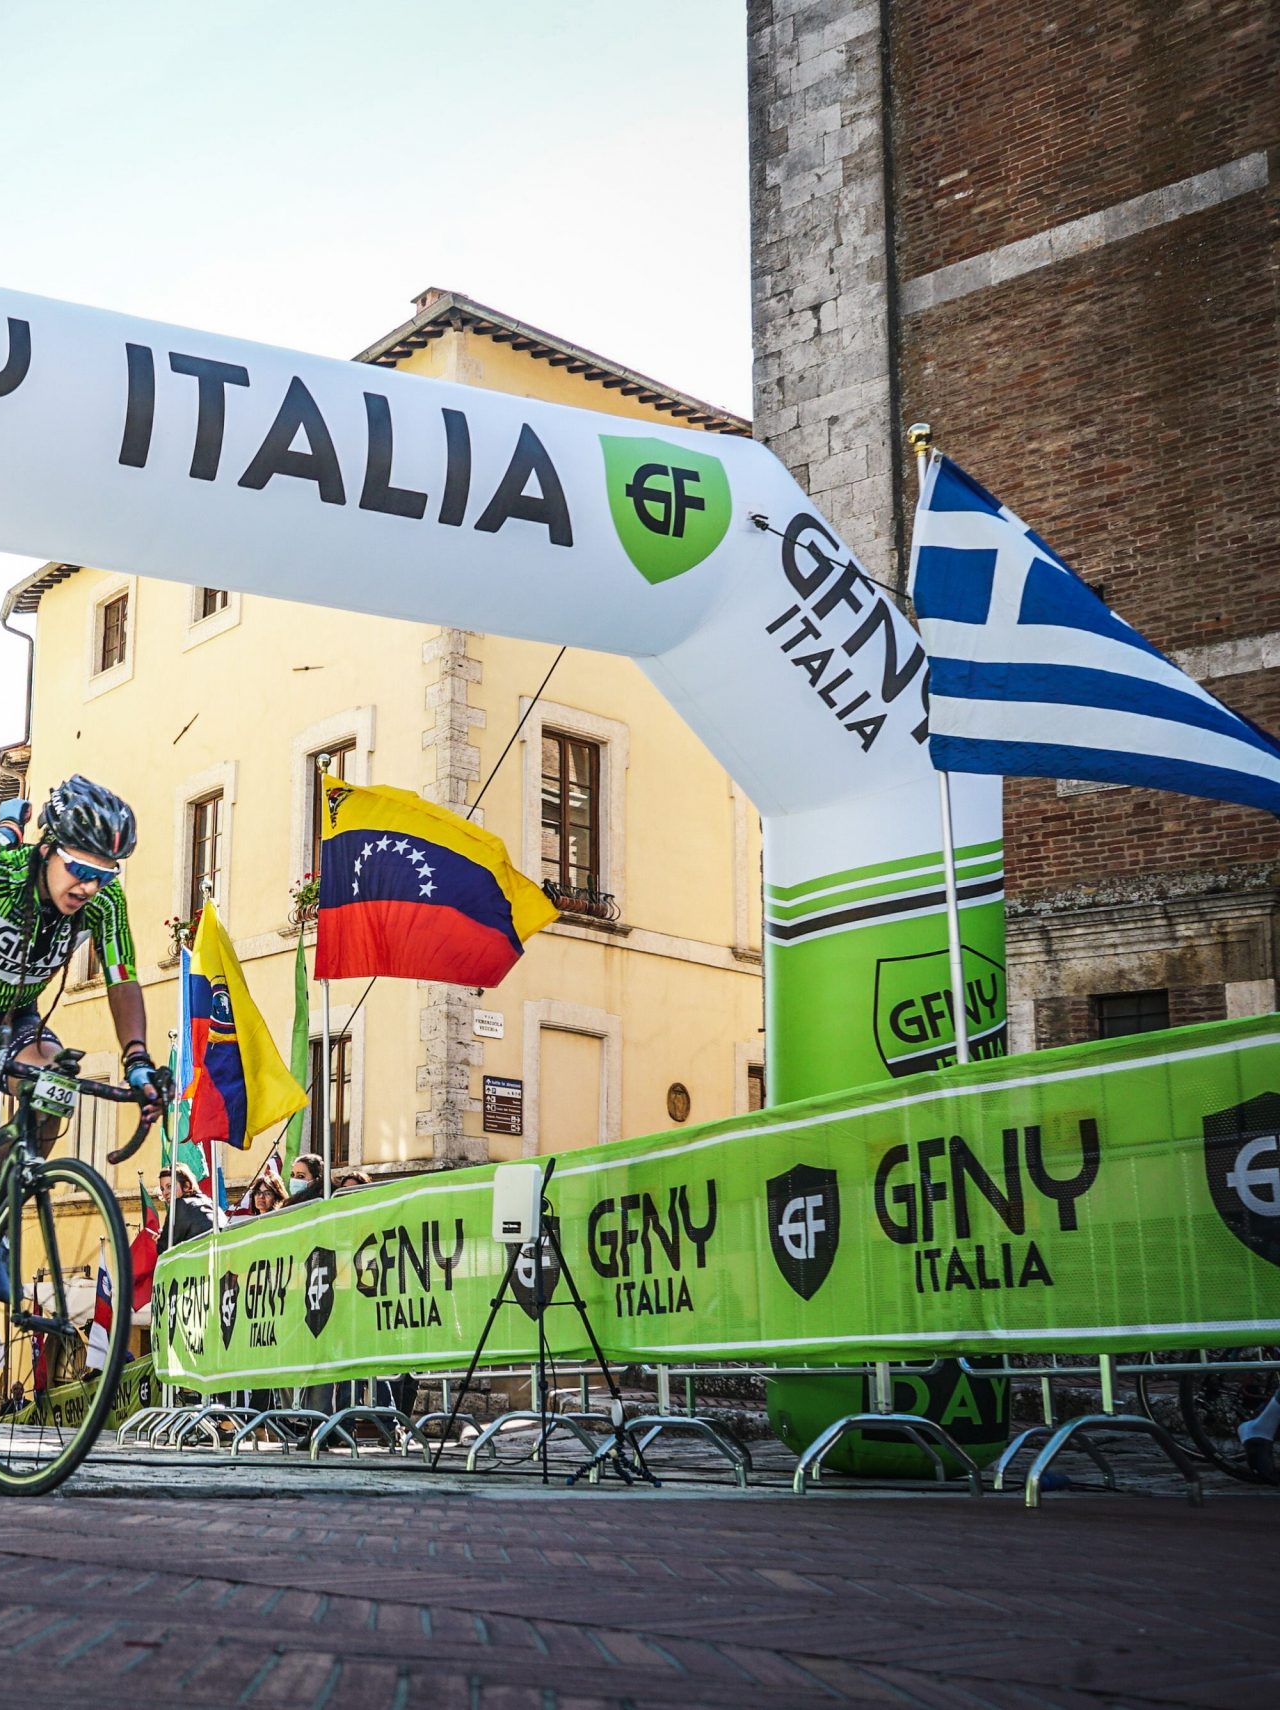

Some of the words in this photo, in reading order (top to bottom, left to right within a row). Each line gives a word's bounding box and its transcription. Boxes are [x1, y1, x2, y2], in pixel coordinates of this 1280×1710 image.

[119, 343, 574, 548] ITALIA
[626, 463, 706, 538] GF
[765, 604, 888, 753] ITALIA
[890, 973, 998, 1044] GFNY
[46, 1085, 73, 1104] 430
[874, 1117, 1100, 1246] GFNY
[353, 1218, 464, 1298] GFNY
[587, 1179, 717, 1278] GFNY
[245, 1254, 294, 1320] GFNY
[615, 1275, 694, 1318] ITALIA
[914, 1240, 1054, 1294] ITALIA
[249, 1320, 278, 1348] ITALIA
[376, 1296, 443, 1331] ITALIA
